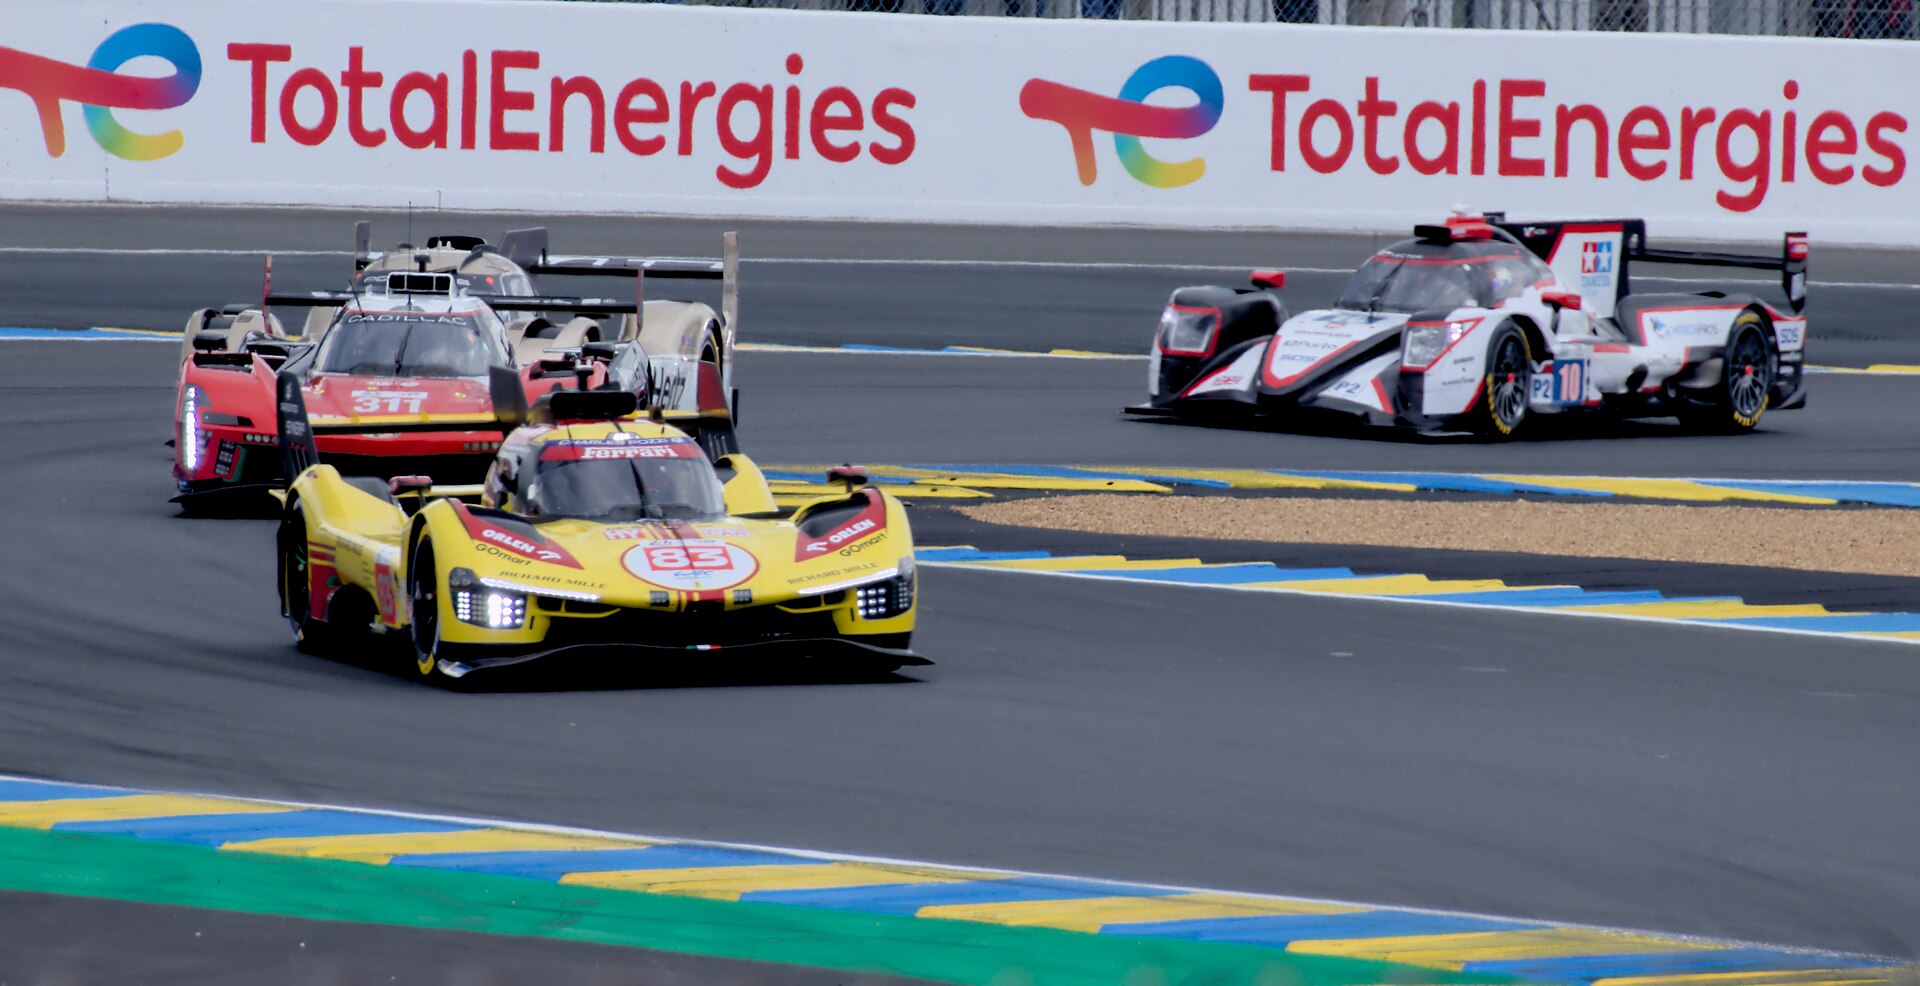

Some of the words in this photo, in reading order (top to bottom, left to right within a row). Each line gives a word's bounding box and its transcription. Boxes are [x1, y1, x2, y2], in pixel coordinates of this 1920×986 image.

[228, 43, 915, 188] TotalEnergies
[1249, 74, 1907, 212] TotalEnergies
[348, 314, 467, 325] CADILLAC
[1334, 381, 1362, 394] P2
[1533, 379, 1551, 400] P2
[1558, 362, 1581, 402] 10
[353, 397, 424, 414] 311
[580, 444, 679, 459] Ferrari
[482, 529, 536, 553] ORLEN
[829, 519, 876, 544] ORLEN
[475, 543, 532, 567] GOmart
[650, 547, 729, 567] 83
[839, 533, 887, 557] GOmart
[500, 570, 562, 583] RICHARD
[566, 578, 607, 590] MILLE
[787, 569, 840, 585] RICHARD
[843, 561, 879, 574] MILLE
